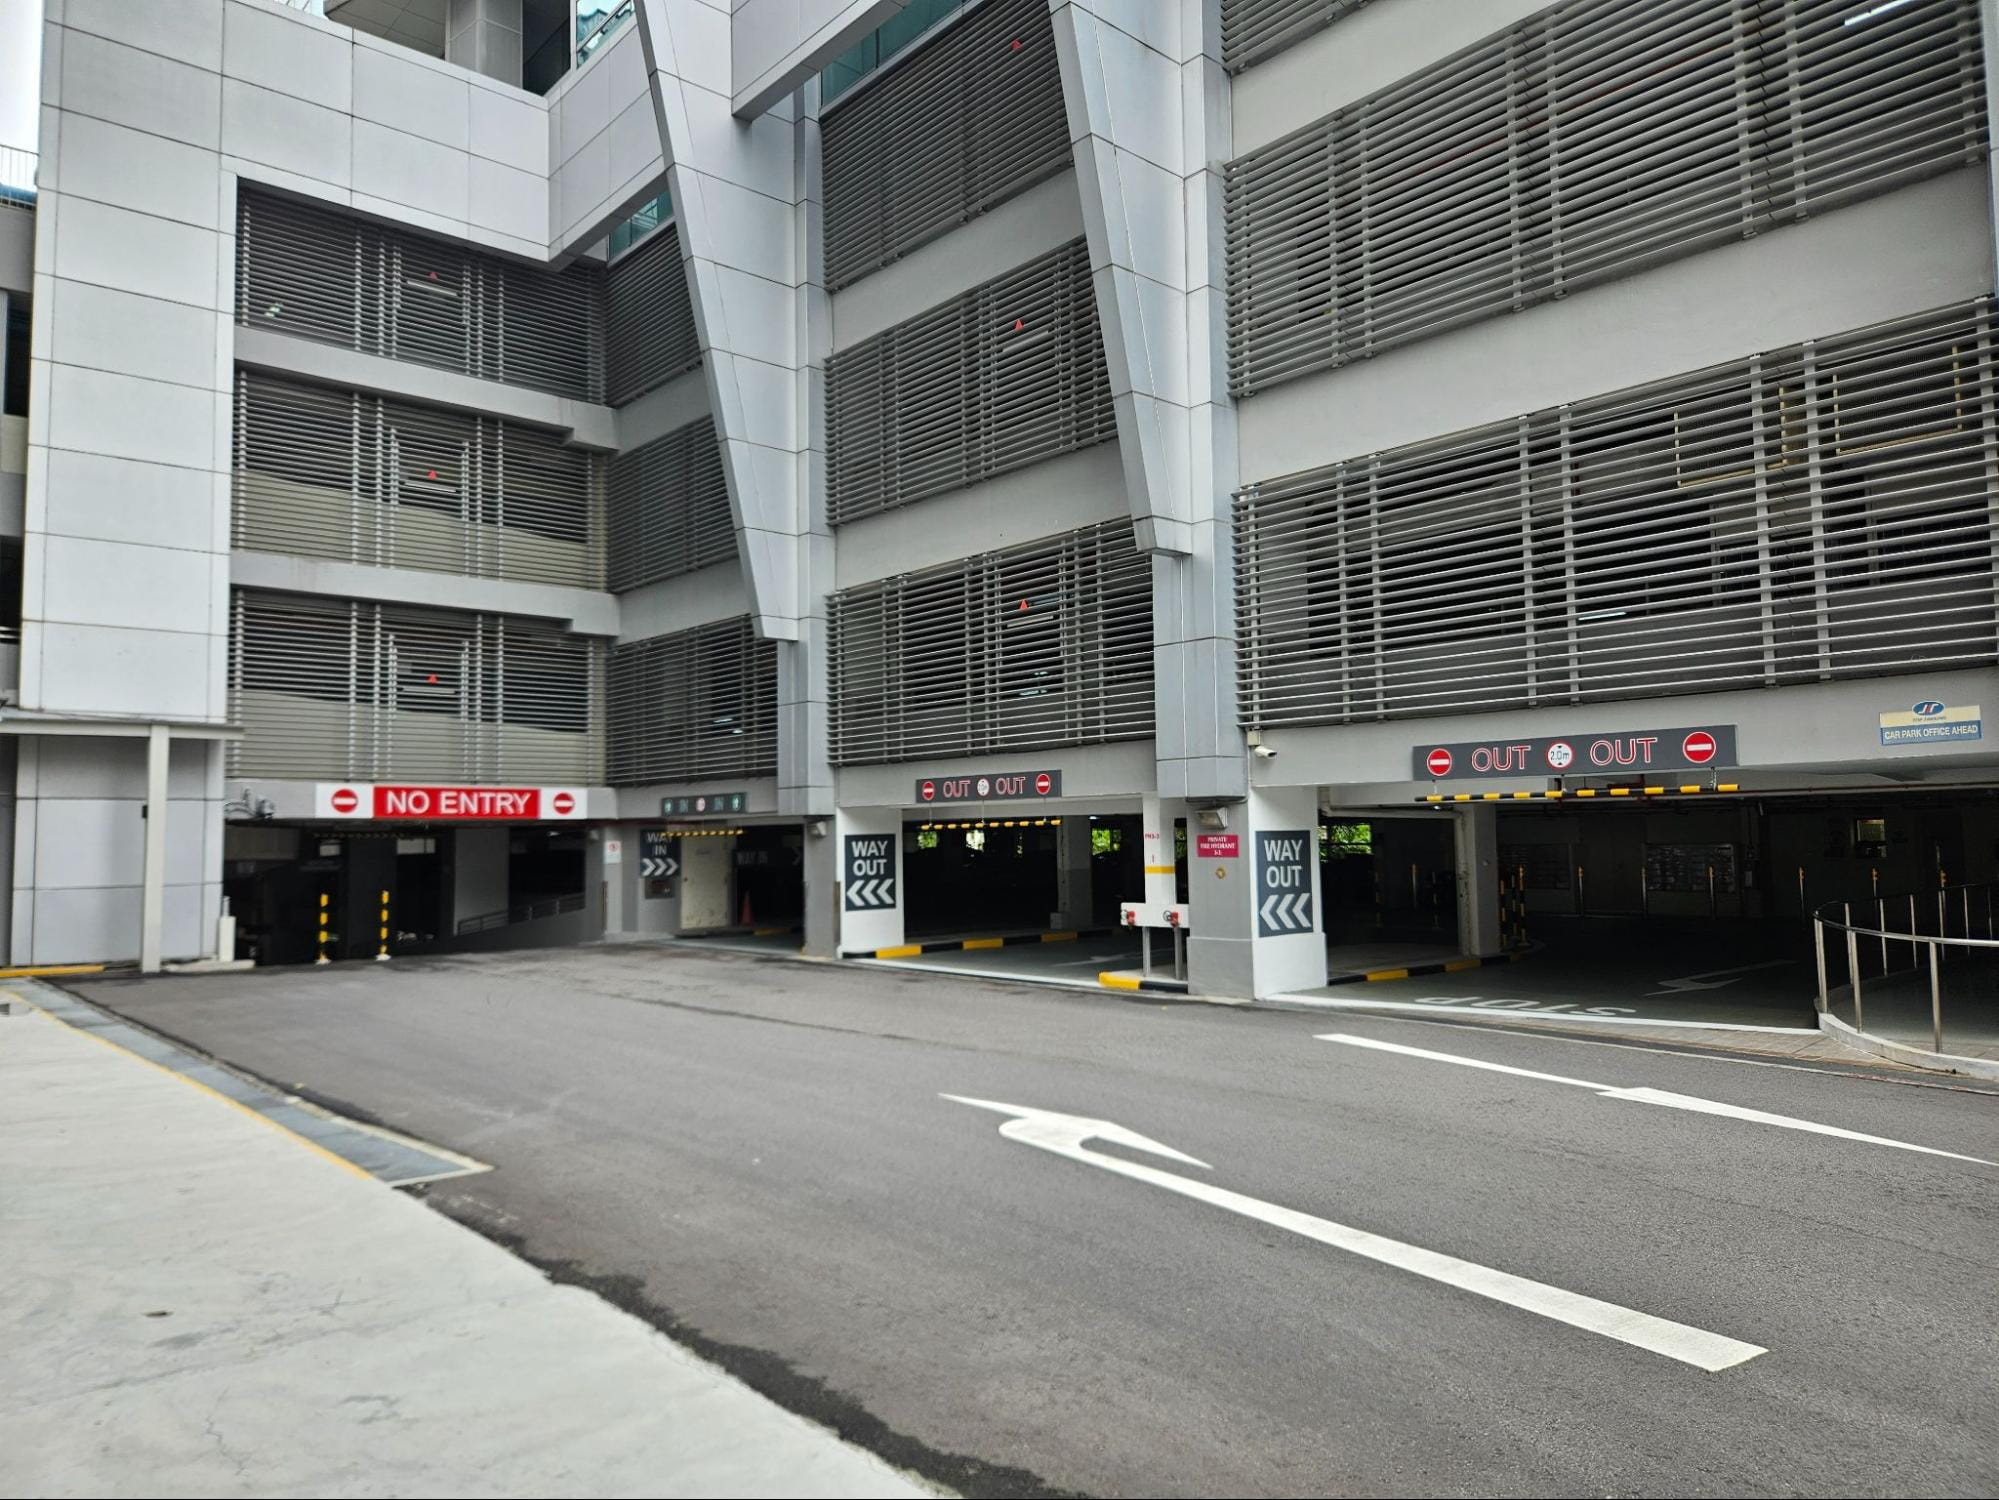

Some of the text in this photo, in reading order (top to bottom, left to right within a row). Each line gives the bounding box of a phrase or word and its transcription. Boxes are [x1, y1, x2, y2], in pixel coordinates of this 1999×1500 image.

[1884, 725, 1978, 740] CAR PARK OFFICE AHEAD
[1471, 737, 1657, 771] OUT 2.0m OUT
[942, 780, 971, 798] OUT
[995, 776, 1026, 795] OUT
[386, 788, 531, 815] NO ENTRY
[851, 841, 888, 858] WAY
[1264, 839, 1303, 862] WAY
[853, 859, 887, 877] OUT
[1266, 865, 1302, 888] OUT
[1415, 997, 1636, 1015] STOP
